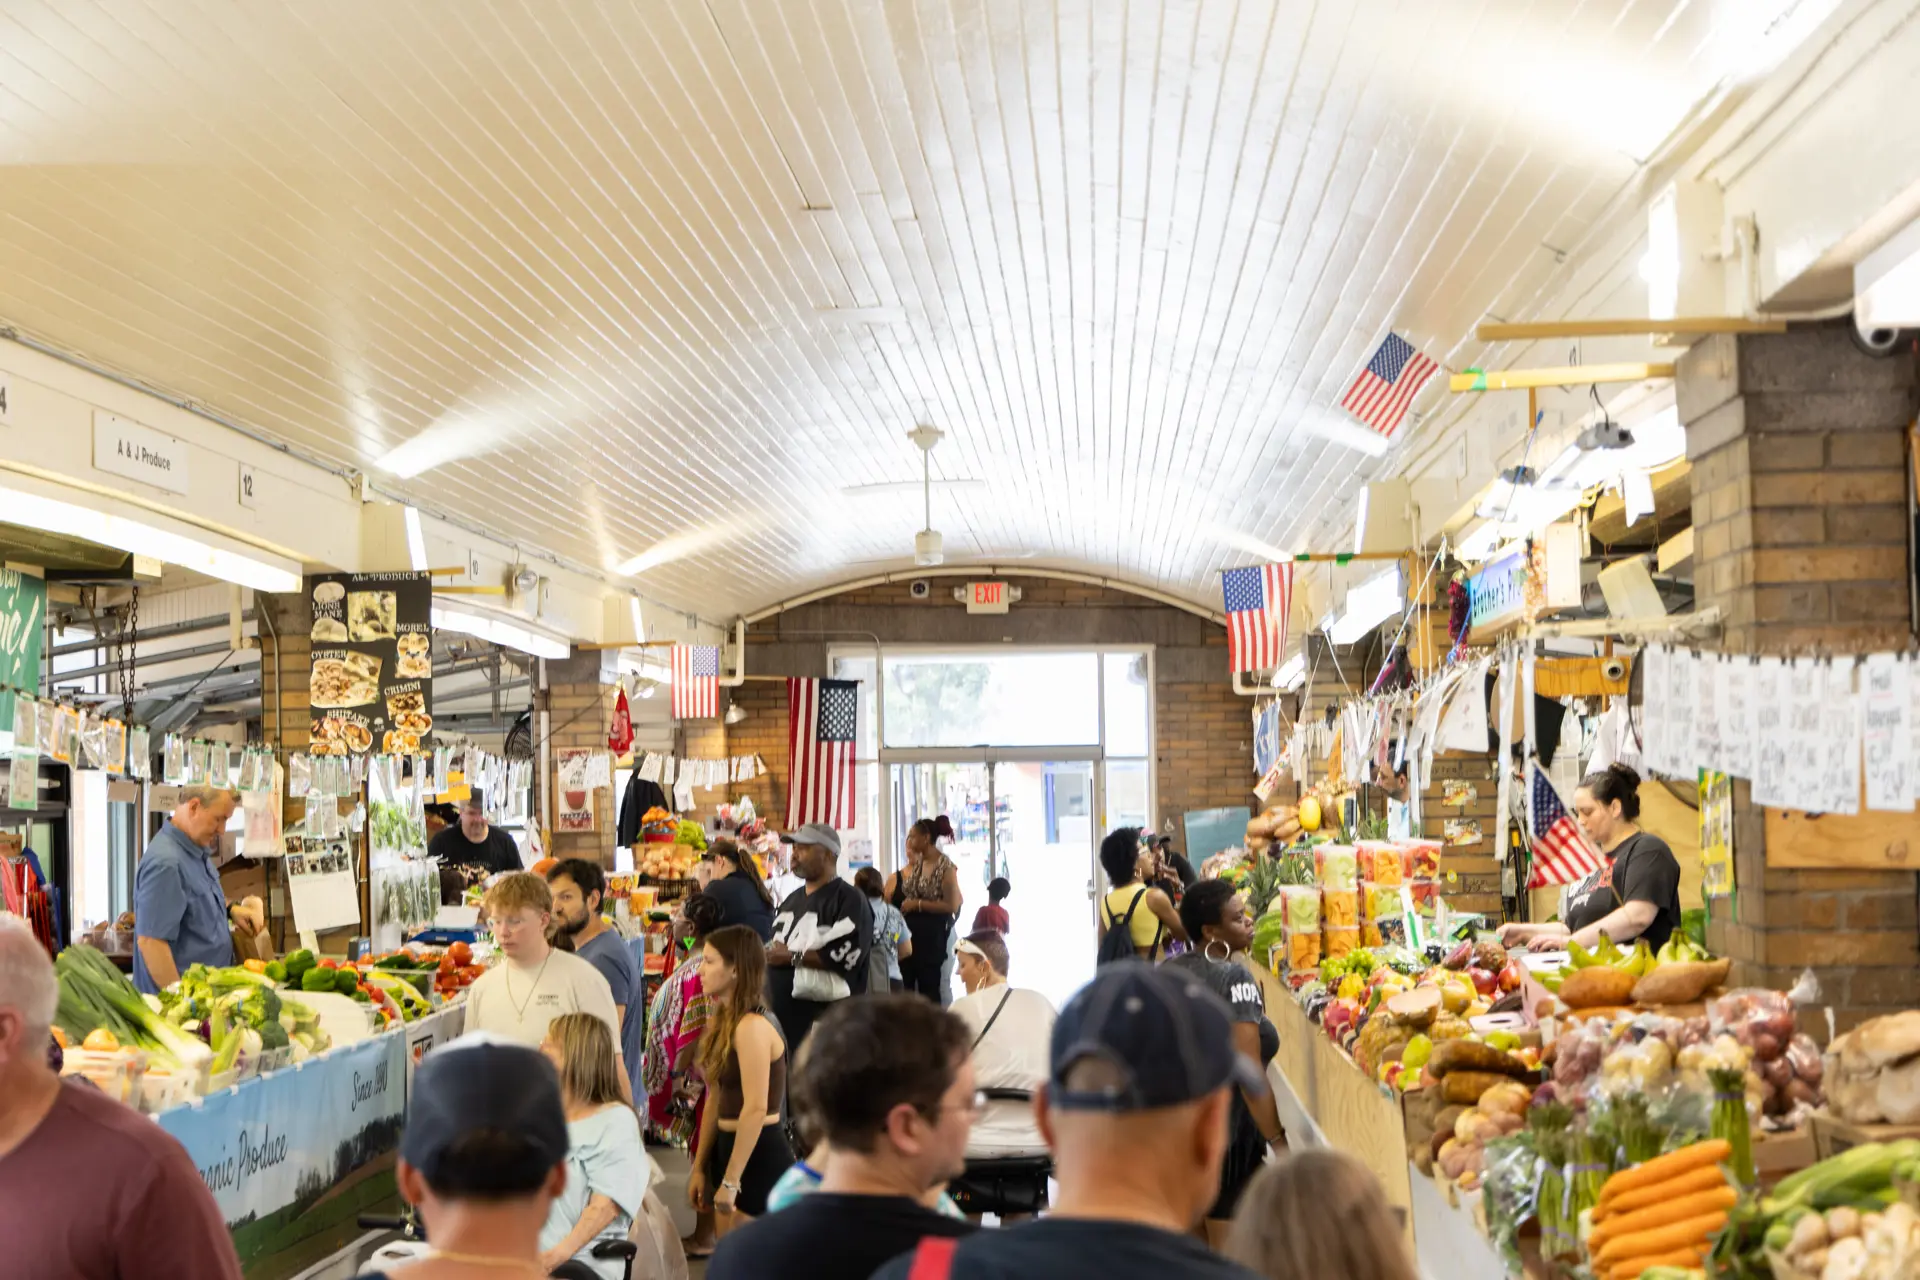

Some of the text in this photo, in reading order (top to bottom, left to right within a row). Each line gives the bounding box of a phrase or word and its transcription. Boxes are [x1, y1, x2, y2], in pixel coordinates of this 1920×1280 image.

[117, 439, 171, 472] A & J Produce
[243, 475, 253, 497] 12
[975, 583, 1002, 604] EXIT
[397, 623, 429, 632] MOREL
[384, 681, 421, 696] CRIMINI
[829, 941, 862, 971] 34
[351, 1071, 374, 1112] Since
[237, 1123, 289, 1192] Produce
